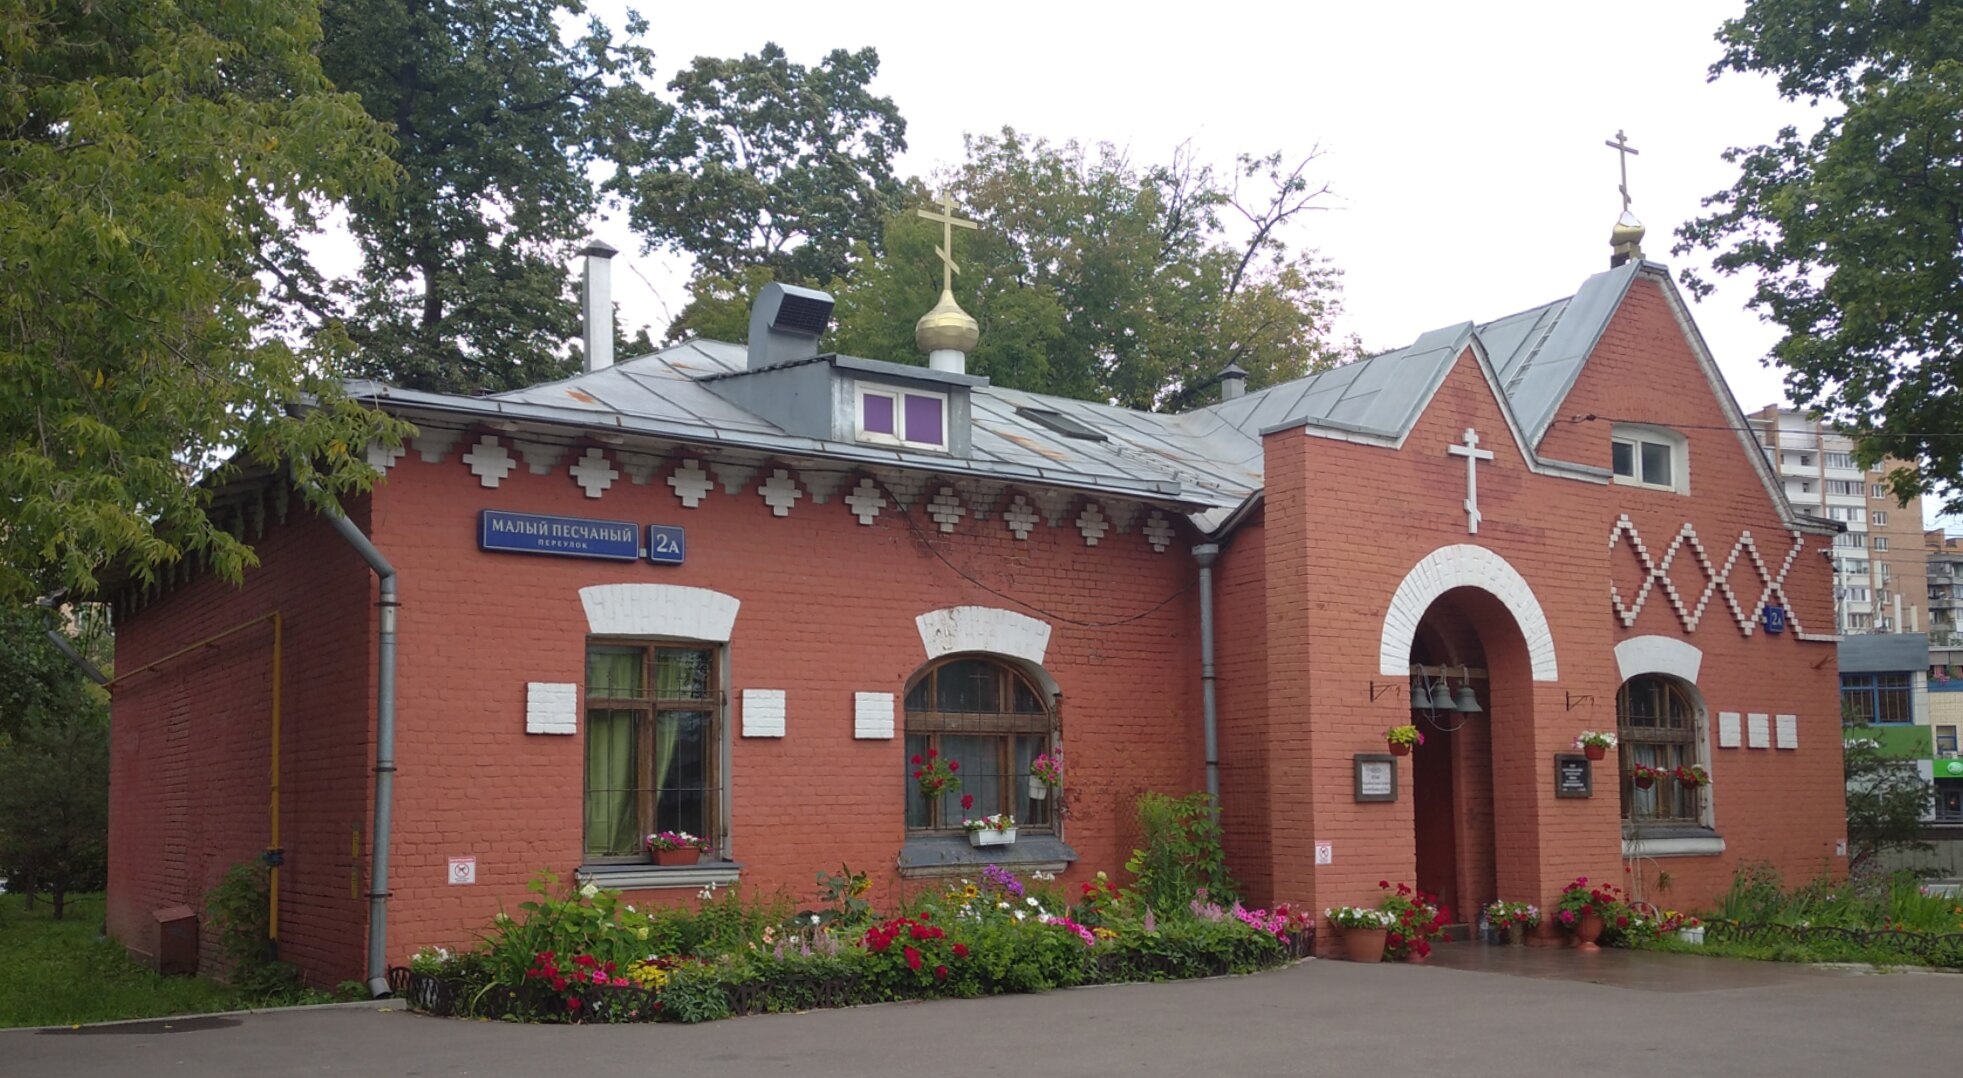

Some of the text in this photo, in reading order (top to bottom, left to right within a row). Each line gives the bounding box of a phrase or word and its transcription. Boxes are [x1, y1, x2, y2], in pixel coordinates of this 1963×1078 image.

[492, 518, 632, 543] МАЛЫЙ ПЕСЧАНЫЙ
[537, 538, 588, 549] ПЕРЕУЛОК
[656, 533, 680, 554] 2А
